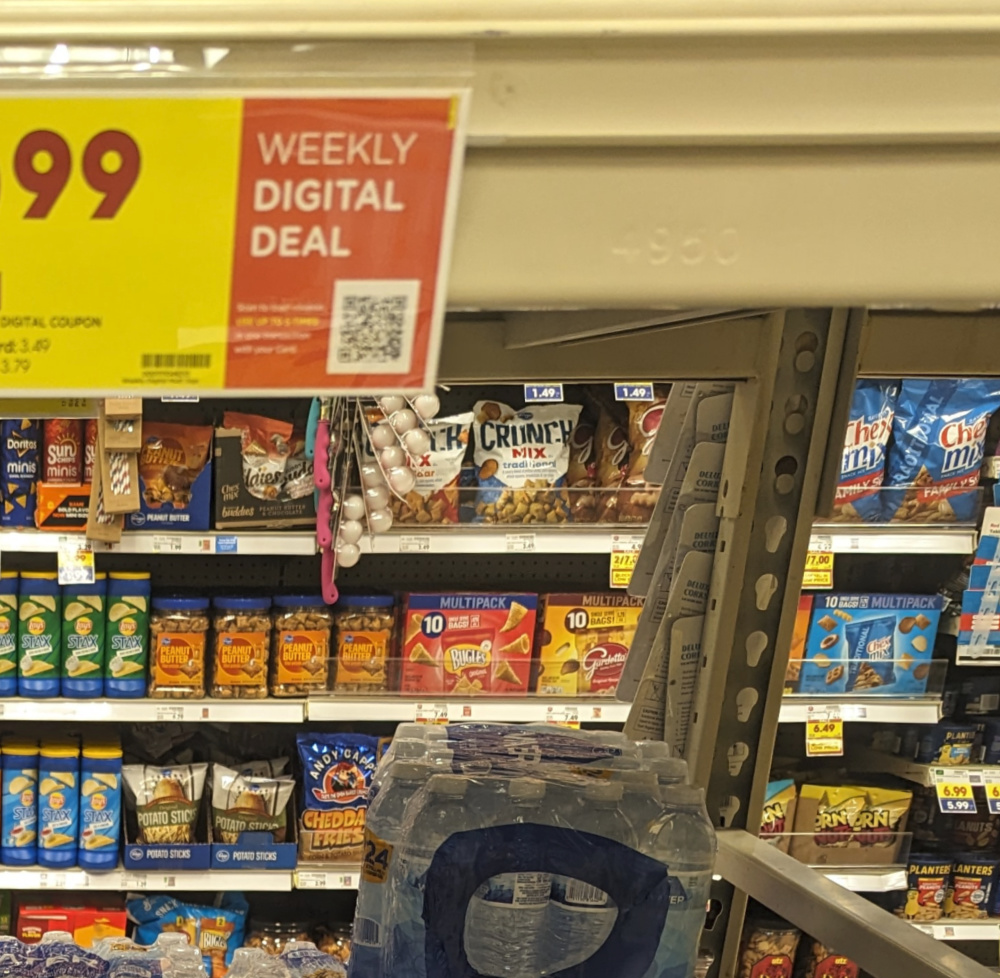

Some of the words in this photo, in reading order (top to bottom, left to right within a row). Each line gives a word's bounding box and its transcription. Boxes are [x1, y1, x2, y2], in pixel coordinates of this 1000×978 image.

[257, 132, 418, 165] WEEKLY
[253, 180, 404, 212] DIGITAL
[250, 226, 351, 257] DEAL
[0, 316, 48, 328] DIGITAL
[50, 316, 102, 328] COUPON
[19, 339, 50, 353] 3.49
[0, 359, 31, 373] 3.79
[532, 388, 555, 397] 1.49
[623, 388, 646, 397] 1.49
[480, 420, 574, 451] CRUNCH
[7, 438, 37, 450] Doritos
[512, 448, 547, 458] MIX
[7, 461, 36, 474] minis
[147, 513, 169, 522] PEANUT
[171, 514, 190, 522] BUTTER
[222, 506, 254, 517] buddies
[440, 597, 506, 609] MULTIPACK
[582, 595, 645, 606] MULTIPACK
[825, 596, 838, 608] 10
[871, 596, 935, 608] MULTIPACK
[424, 615, 444, 633] 10
[567, 612, 587, 628] 10
[222, 645, 252, 655] PEANUT
[283, 643, 313, 655] PEANUT
[343, 644, 373, 655] PEANUT
[222, 654, 250, 664] BUTTER
[283, 652, 312, 662] BUTTER
[342, 652, 371, 663] BUTTER
[451, 649, 485, 671] BUGLES
[813, 723, 835, 733] 6.49
[310, 750, 338, 780] ANDY
[943, 785, 967, 797] 6.99
[947, 801, 969, 811] 5.99
[42, 808, 71, 822] STAX
[83, 810, 114, 823] STAX
[138, 812, 168, 826] POTATO
[312, 827, 365, 848] FRIES
[147, 850, 170, 859] POTATO
[171, 850, 190, 859] STICKS
[233, 852, 256, 860] POTATO
[257, 851, 277, 861] STICKS
